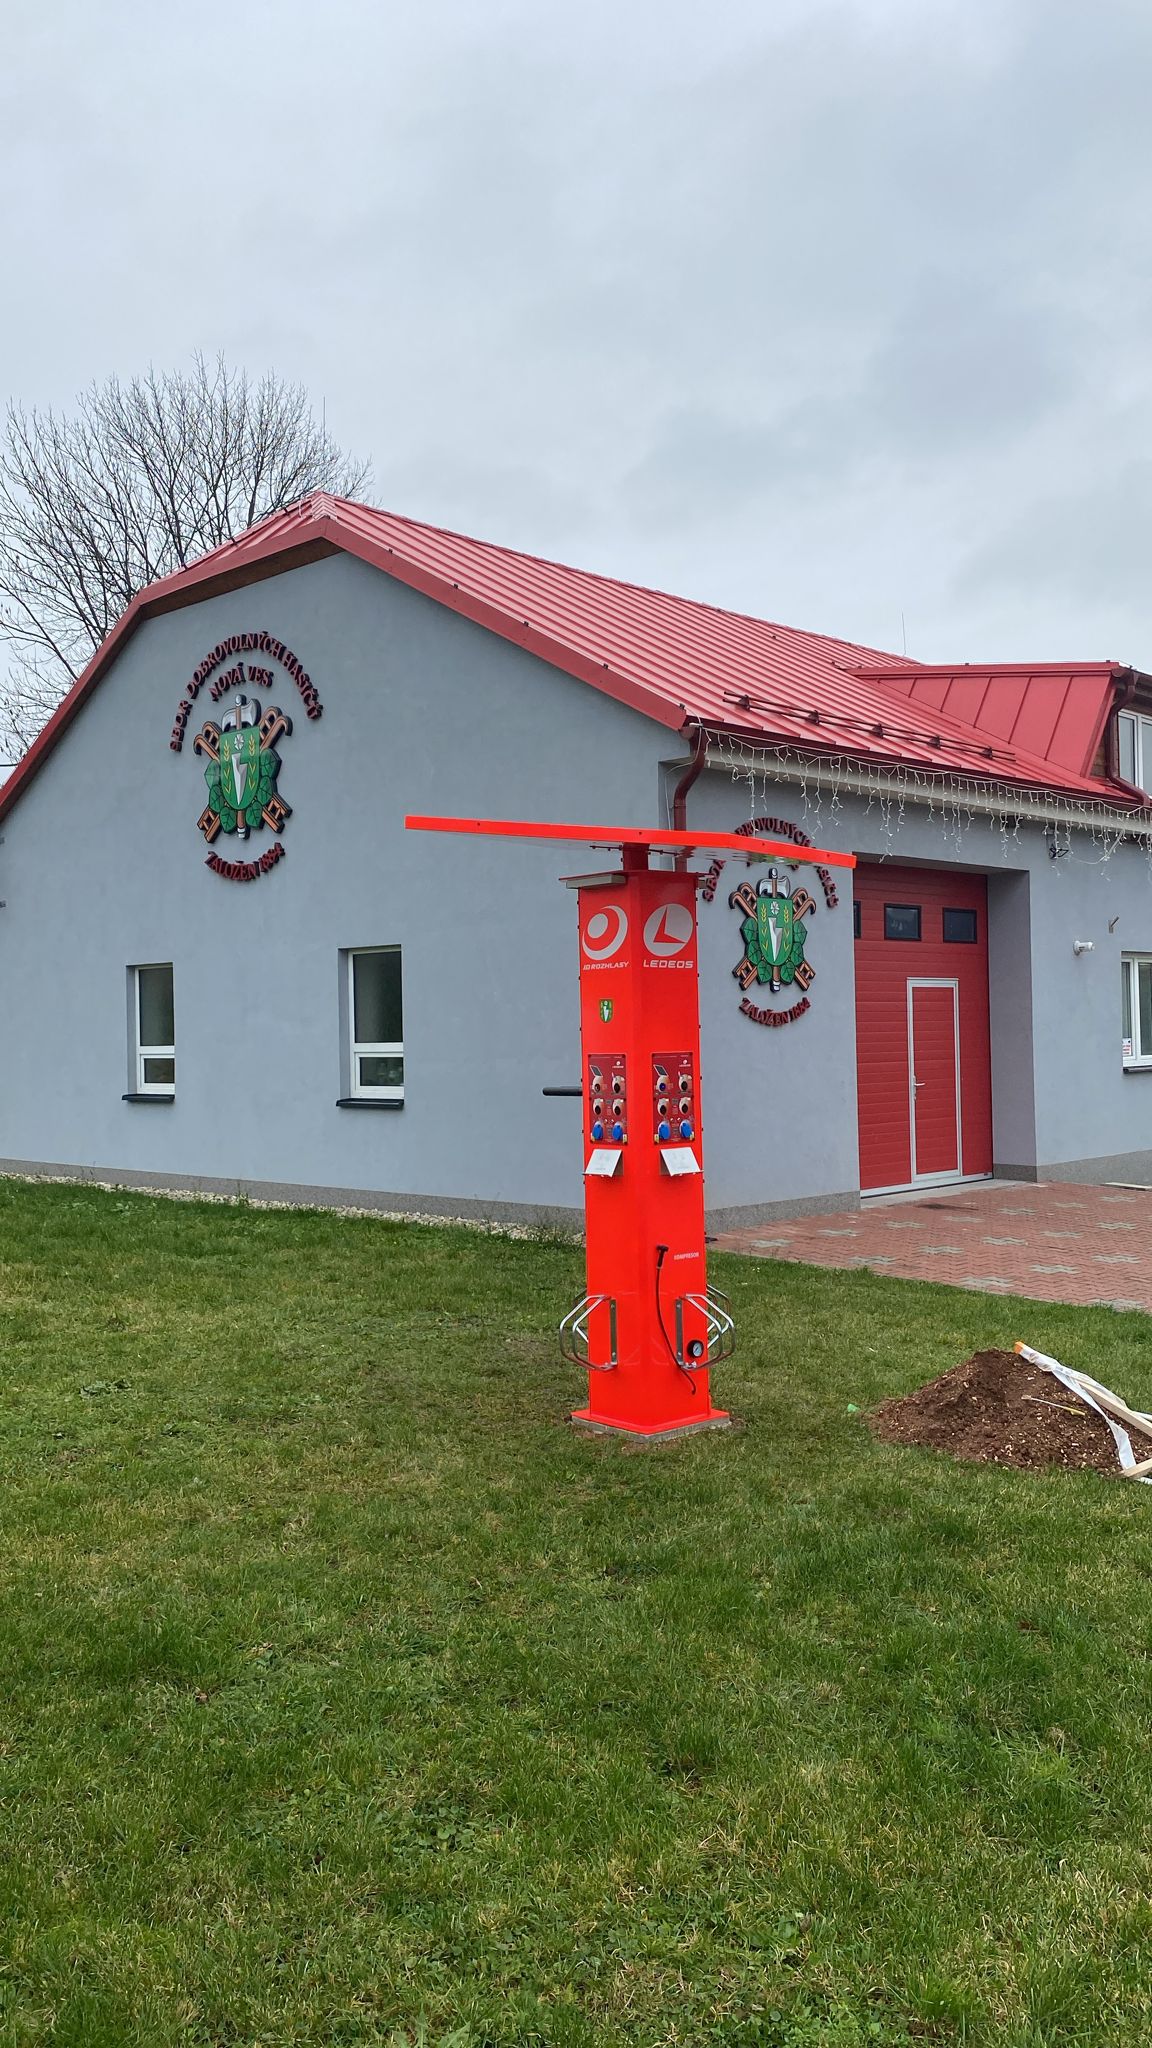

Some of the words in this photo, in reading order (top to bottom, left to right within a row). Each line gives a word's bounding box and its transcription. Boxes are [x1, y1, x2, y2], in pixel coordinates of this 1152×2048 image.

[170, 699, 193, 752] SBOR
[186, 631, 286, 699] DOBROVOLNÝCH
[282, 651, 323, 720] HASIČŮ
[209, 662, 245, 701] NOVÁ
[247, 665, 274, 688] VES
[204, 851, 260, 881] ZALOŽEN
[591, 961, 629, 970] ROZHLASY
[643, 959, 694, 969] LEDEOS
[739, 997, 789, 1026] ZALOŽEN
